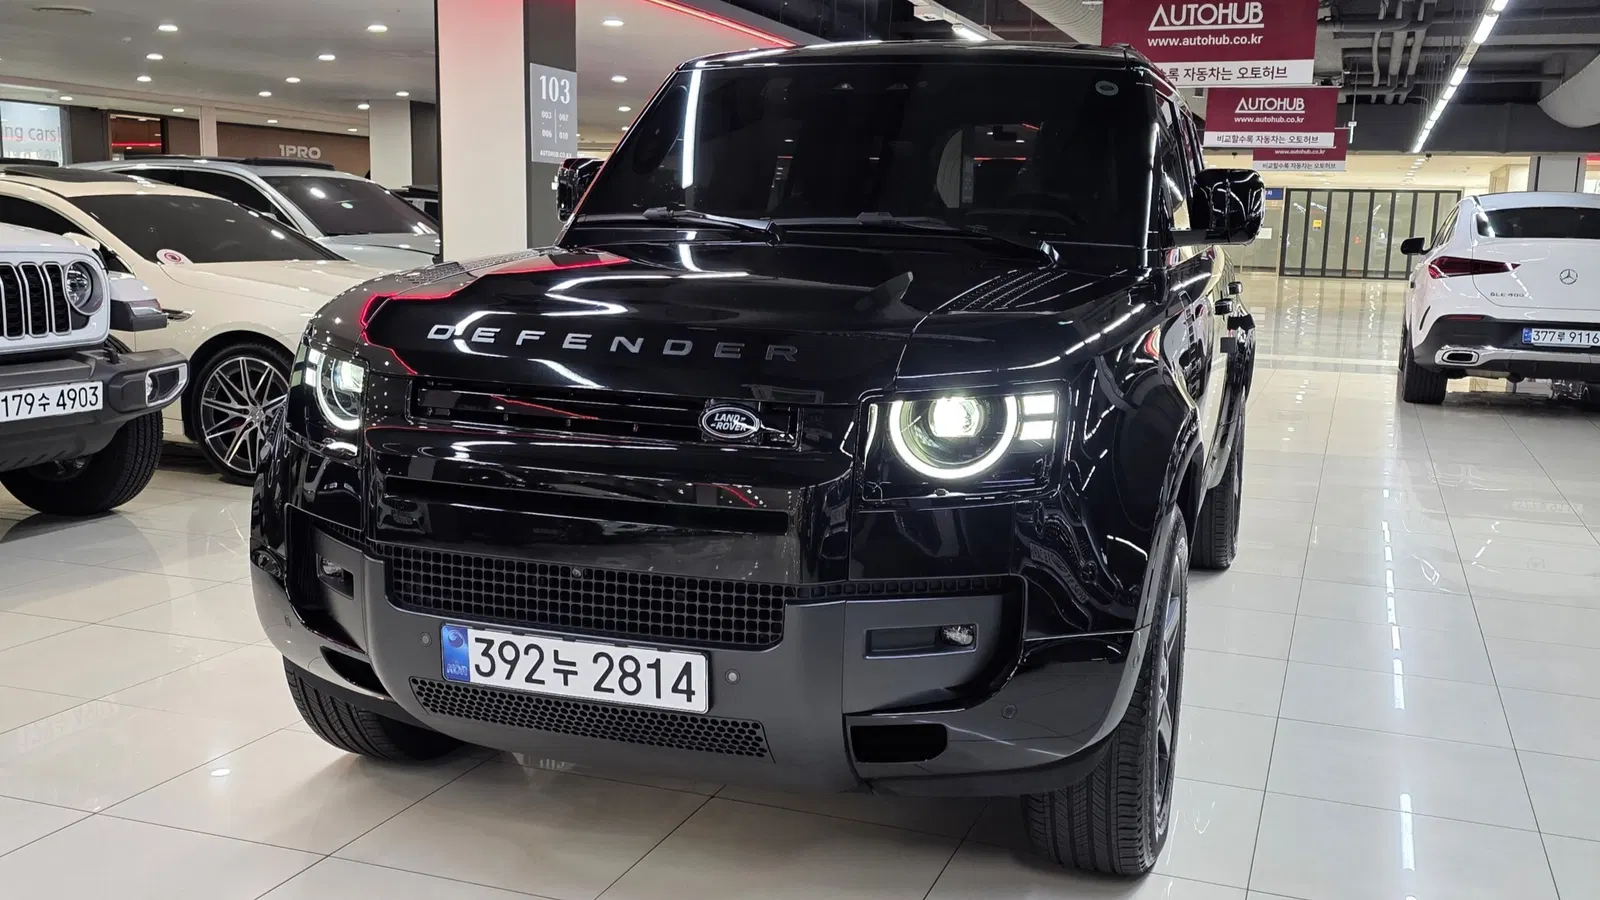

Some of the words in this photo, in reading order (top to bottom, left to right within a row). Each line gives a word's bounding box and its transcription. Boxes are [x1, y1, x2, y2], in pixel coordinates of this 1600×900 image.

[1148, 2, 1264, 31] AUTOHUB
[1148, 33, 1263, 47] www.autohub.co.kr
[1183, 67, 1233, 81] 자동차는
[1236, 65, 1288, 80] 오토허브
[540, 75, 570, 104] 103
[1235, 97, 1305, 114] AUTOHUB
[1234, 116, 1305, 124] www.autohub.co.kr
[1216, 135, 1253, 144] 비교할수록
[1256, 135, 1285, 145] 자동차는
[1288, 136, 1319, 145] 오토허브
[279, 144, 321, 160] 1PRO
[427, 323, 798, 362] DEFENDER
[1569, 331, 1600, 344] 9116
[2, 392, 51, 418] 179수
[56, 386, 99, 411] 4903
[714, 413, 740, 422] LAND
[716, 421, 747, 432] ROVER
[474, 636, 578, 687] 392누
[592, 651, 696, 703] 2814
